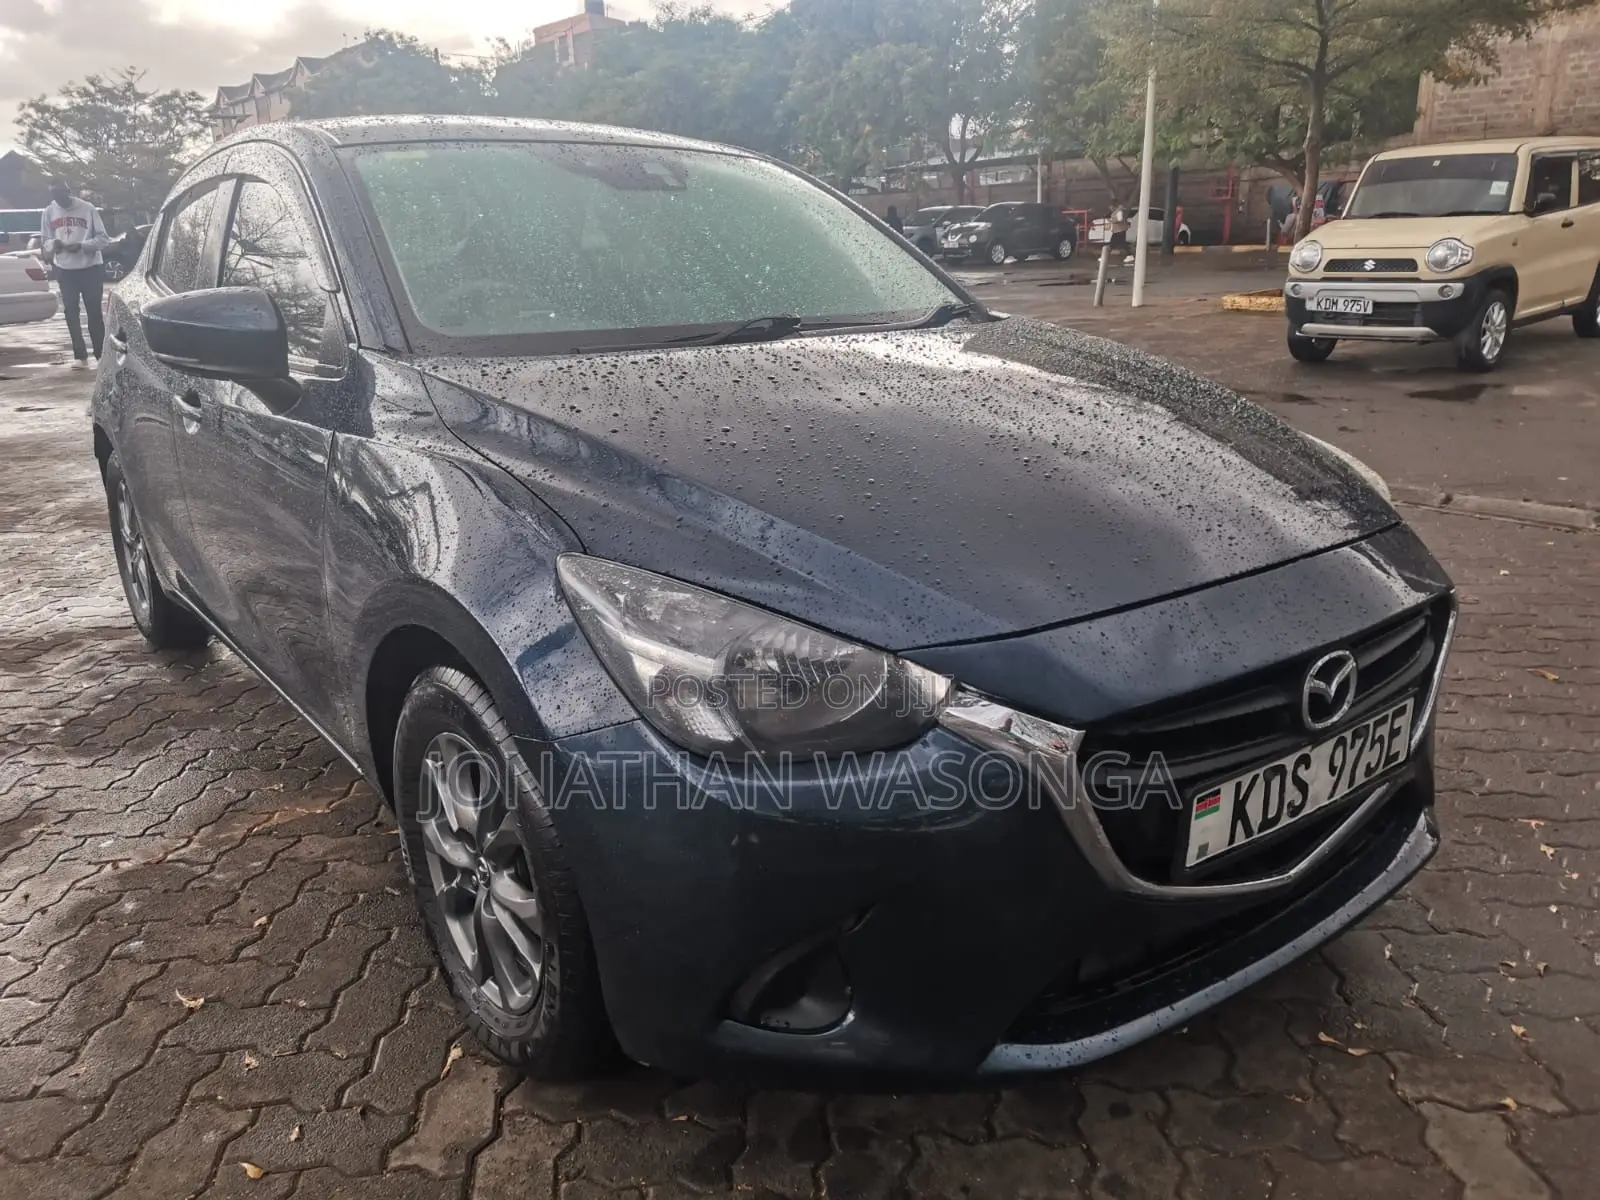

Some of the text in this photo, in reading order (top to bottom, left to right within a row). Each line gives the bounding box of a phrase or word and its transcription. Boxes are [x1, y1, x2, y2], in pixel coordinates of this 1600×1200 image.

[1316, 297, 1370, 313] KDM 975V
[1227, 703, 1409, 846] KDS 975E
